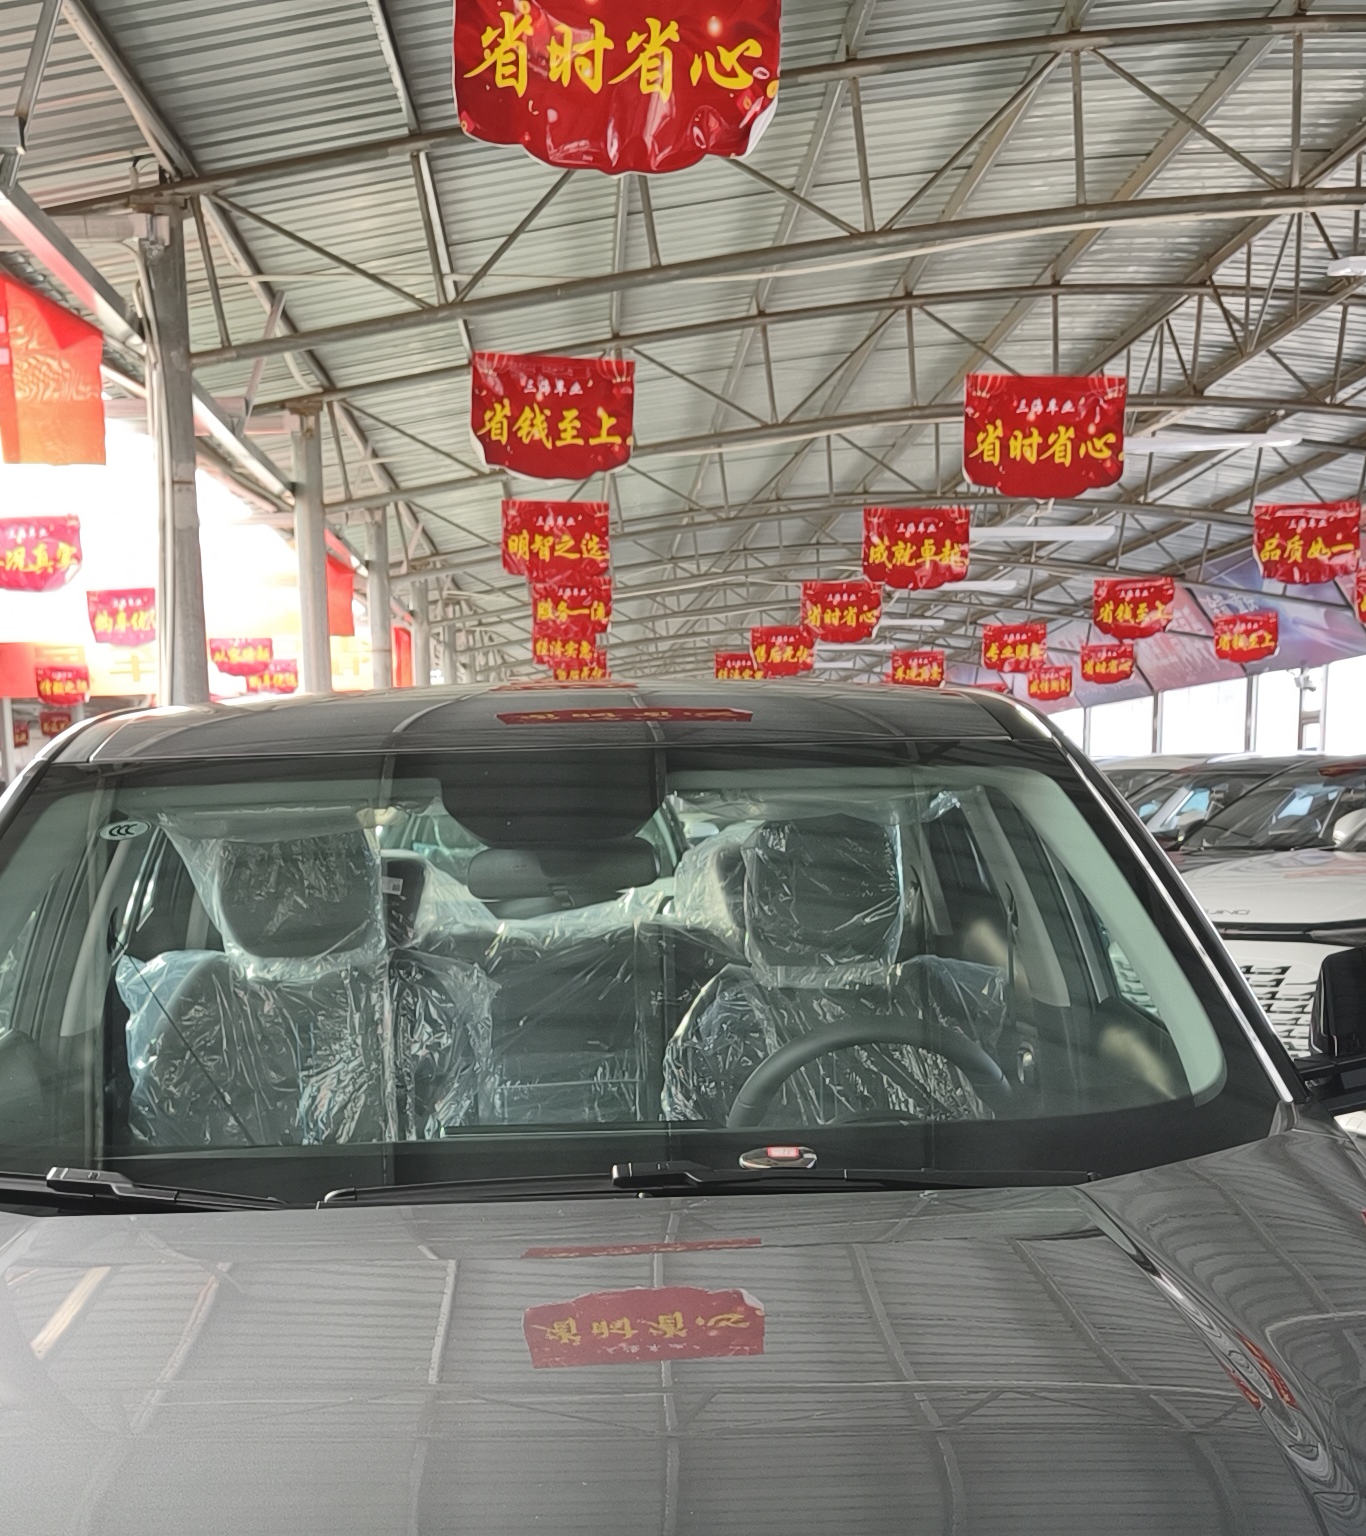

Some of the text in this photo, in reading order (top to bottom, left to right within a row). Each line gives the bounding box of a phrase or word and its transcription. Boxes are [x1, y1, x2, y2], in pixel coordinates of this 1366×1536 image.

[463, 11, 762, 103] 省时省心
[477, 398, 622, 449] 省钱至上
[968, 418, 1116, 467] 省时省心
[508, 529, 609, 562] 明智之选
[869, 538, 963, 568] 成就卓越
[1260, 534, 1354, 563] 品质如一
[537, 598, 605, 621] 服务一流
[805, 604, 877, 627] 省时省心
[1096, 600, 1172, 625] 省钱至上
